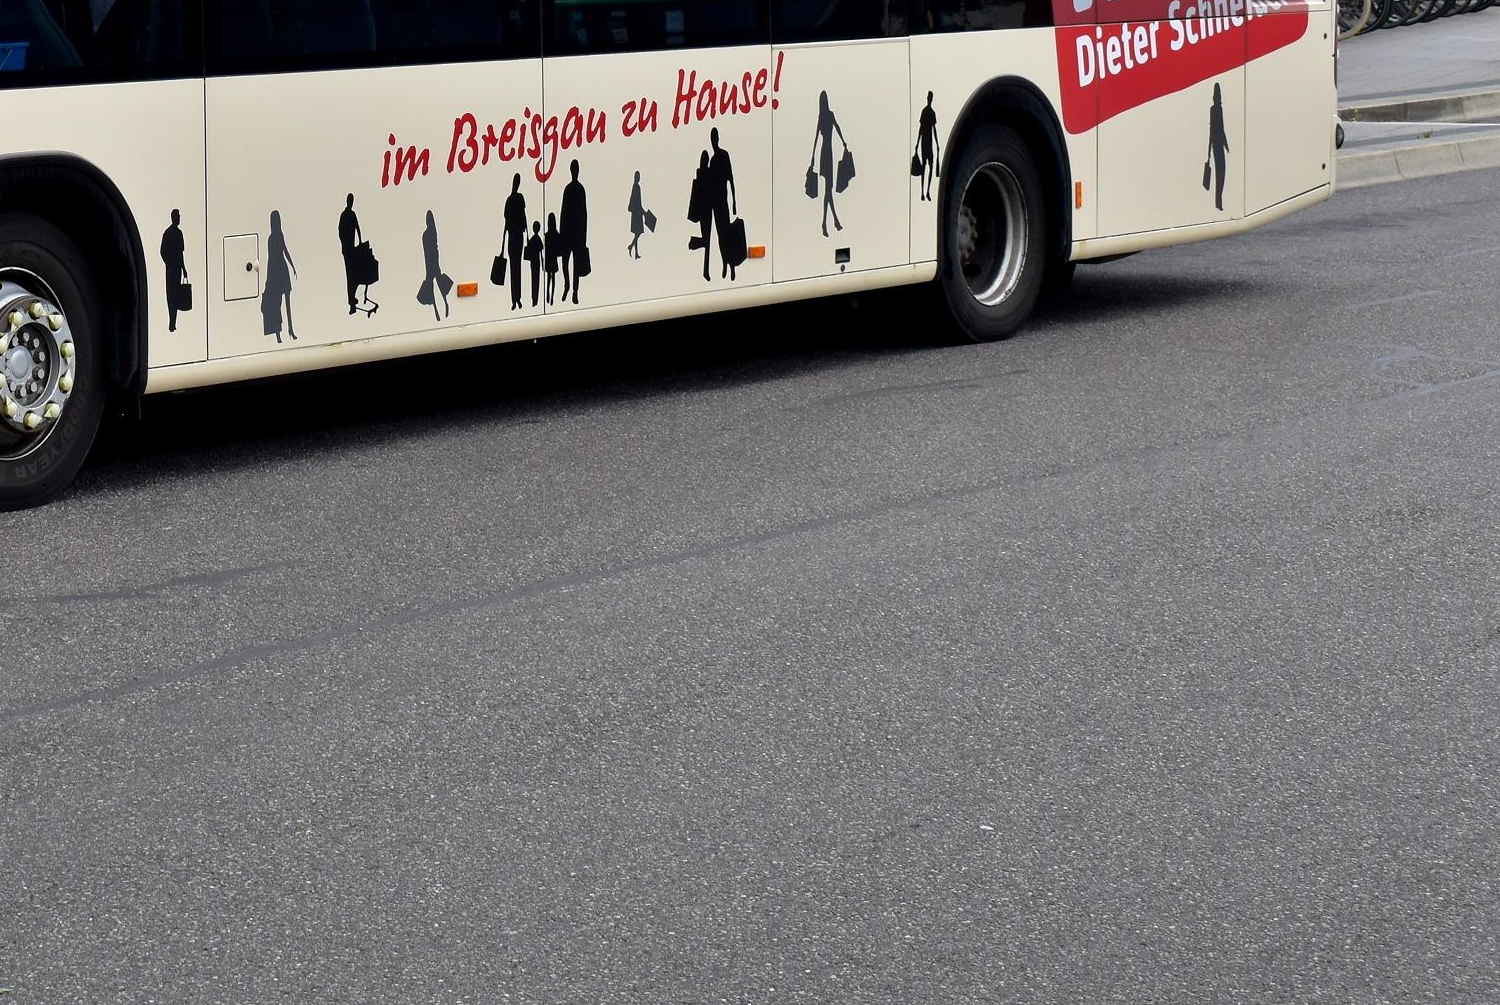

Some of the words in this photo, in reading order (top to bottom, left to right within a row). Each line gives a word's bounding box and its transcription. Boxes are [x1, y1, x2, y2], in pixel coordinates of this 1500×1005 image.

[1075, 20, 1161, 88] Dieter
[381, 133, 430, 188] im
[446, 106, 606, 183] Breisgau
[621, 94, 658, 138] zu
[672, 51, 785, 129] Hause!
